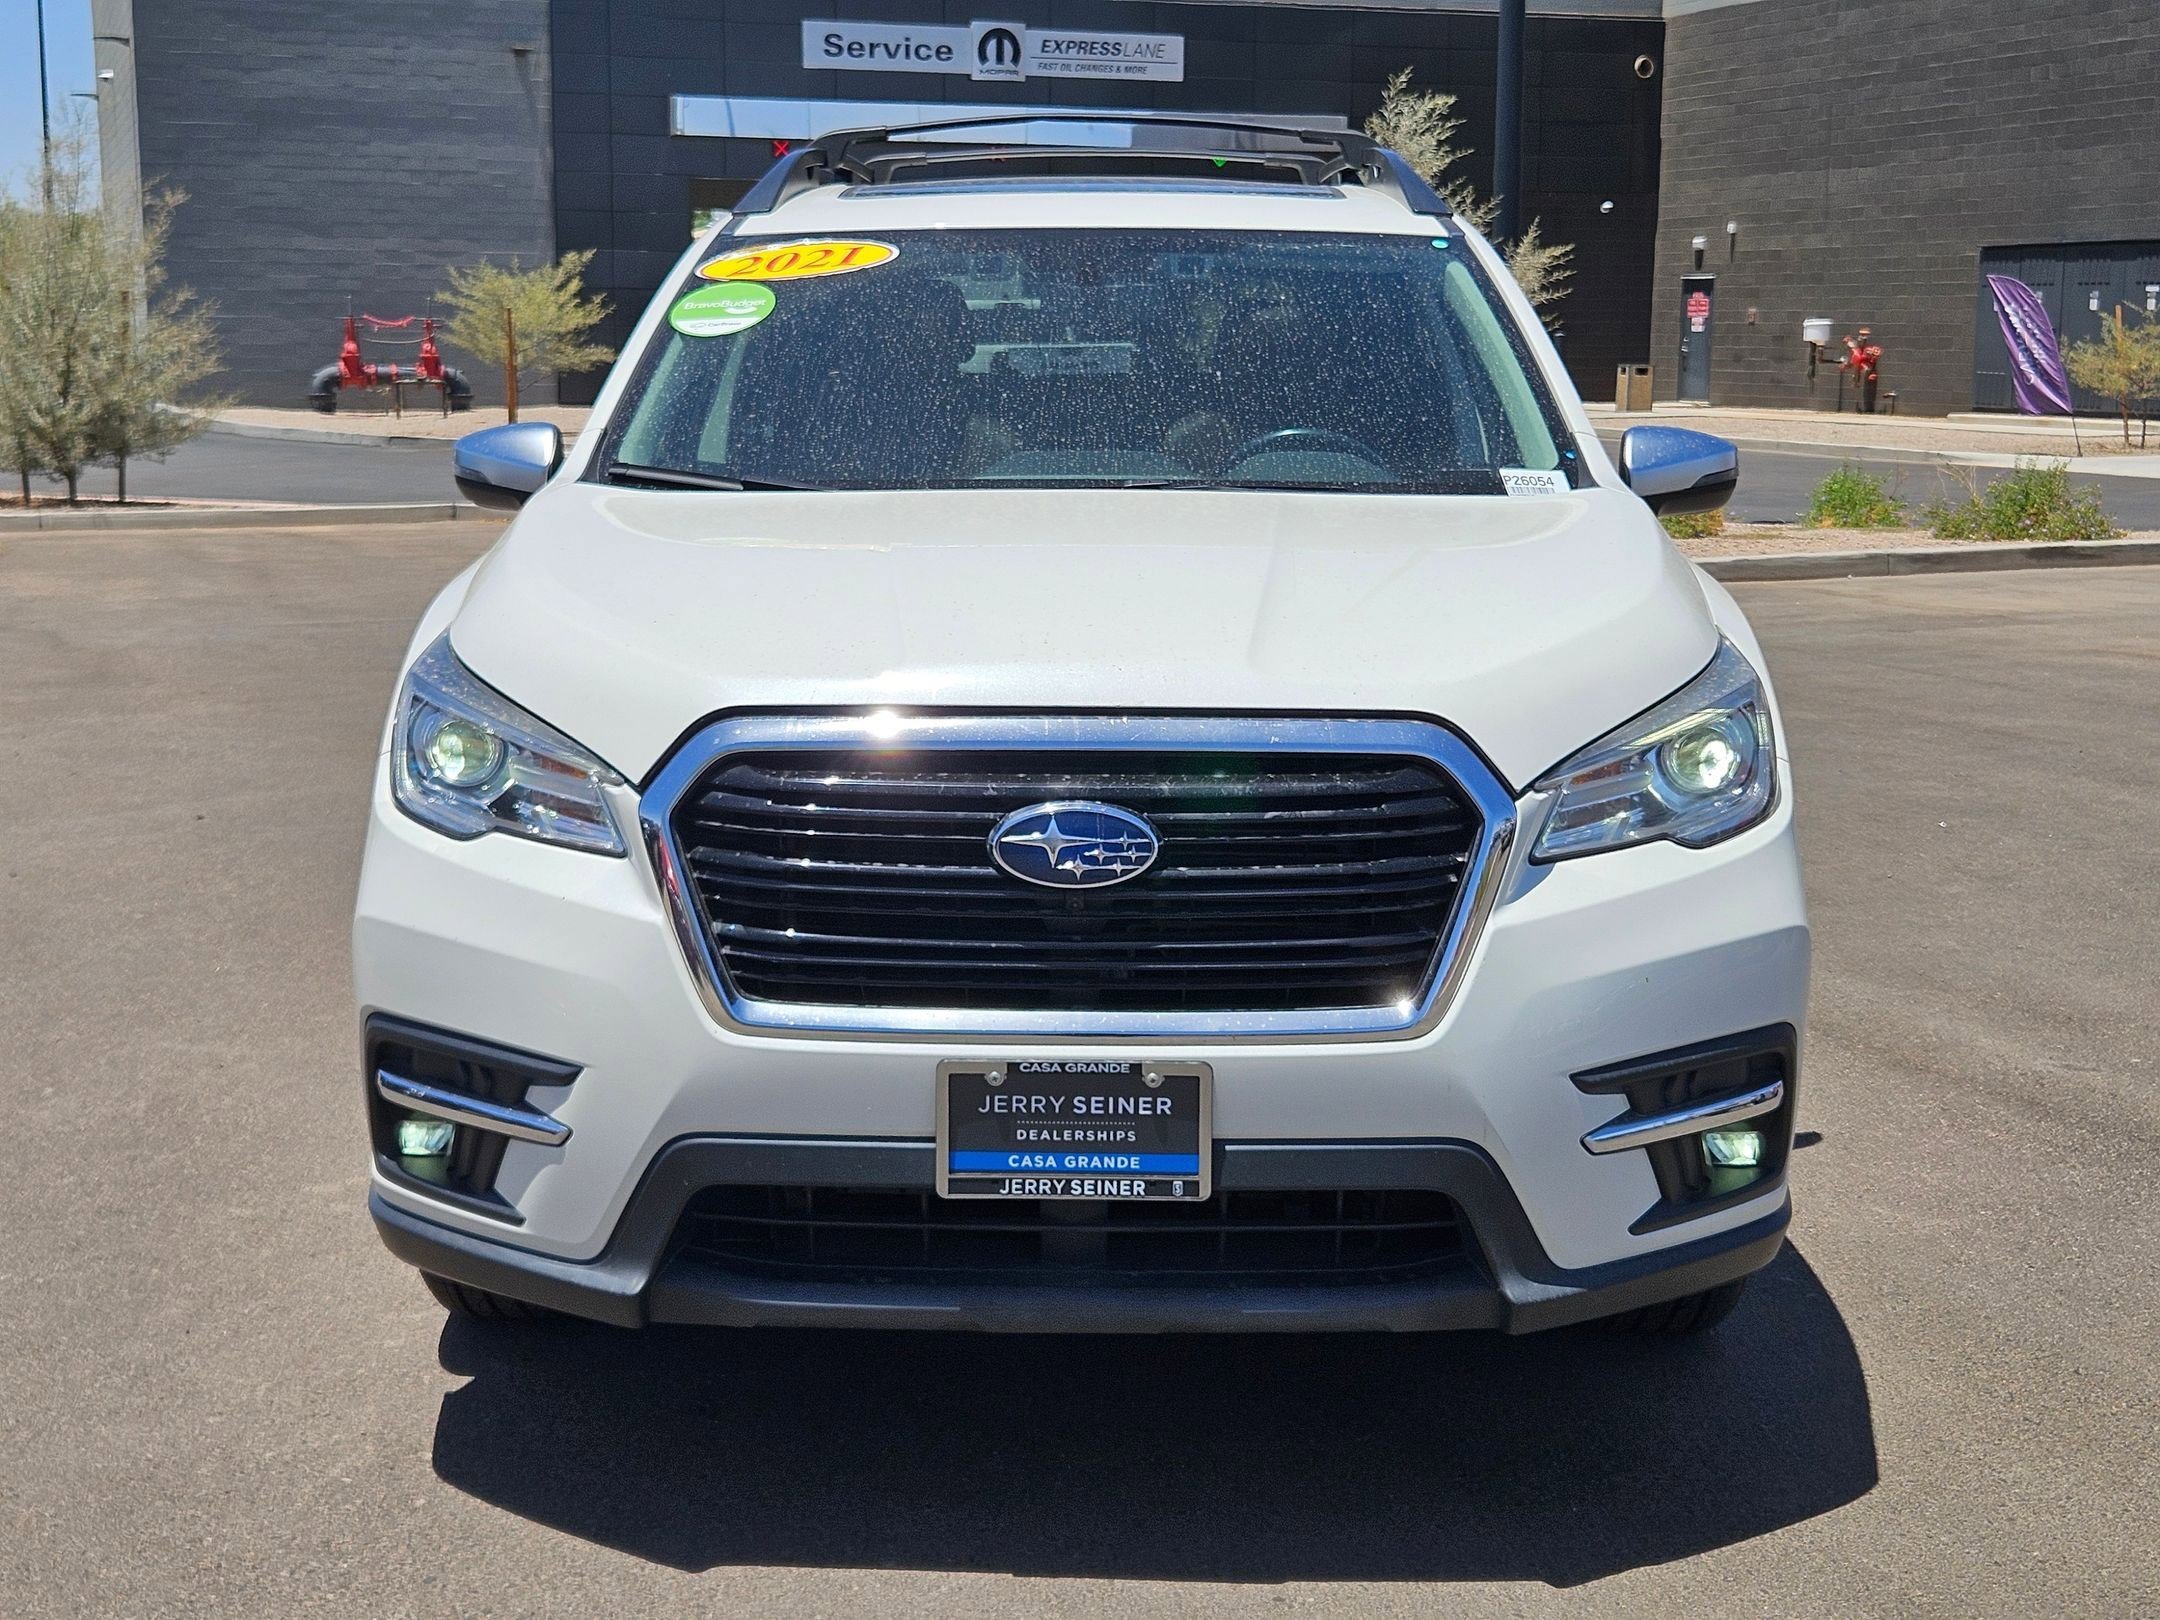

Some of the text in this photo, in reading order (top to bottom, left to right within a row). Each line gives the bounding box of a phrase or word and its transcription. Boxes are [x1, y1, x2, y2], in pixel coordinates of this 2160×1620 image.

[823, 32, 954, 63] Service
[1037, 62, 1148, 74] FAST OIL CHANGES & MORE
[727, 246, 866, 278] 2021
[683, 299, 767, 310] BravoBudget
[1503, 475, 1555, 487] P26054
[1019, 1062, 1131, 1074] CASA GRANDE
[978, 1095, 1173, 1115] JERRY SEINER
[1016, 1129, 1137, 1142] DEALERSHIPS
[1008, 1154, 1141, 1169] CASA GRANDE
[999, 1178, 1146, 1196] JERRY SEINER
